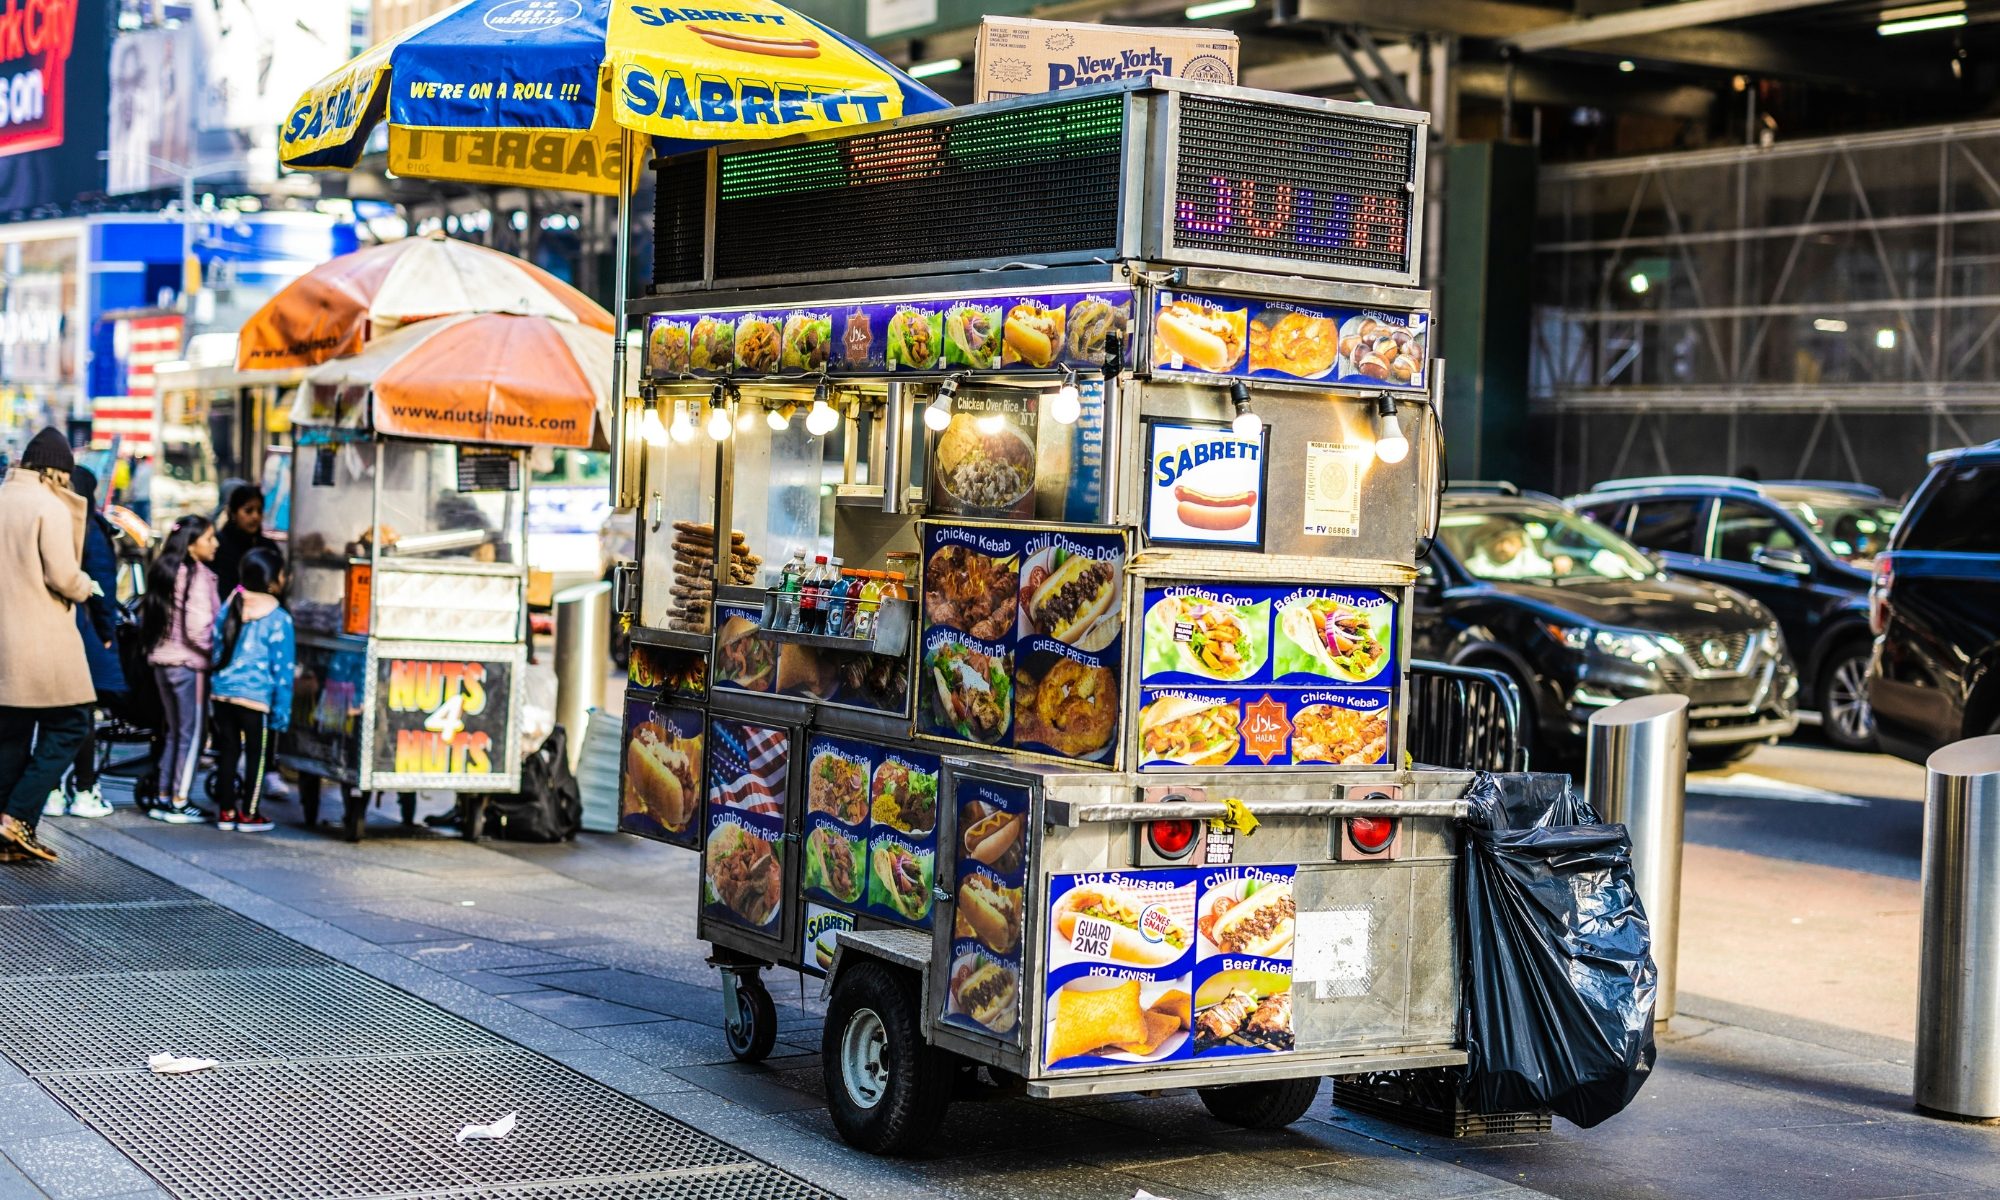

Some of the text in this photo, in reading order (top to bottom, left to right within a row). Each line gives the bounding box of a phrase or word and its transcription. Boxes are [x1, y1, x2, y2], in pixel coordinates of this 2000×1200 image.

[631, 5, 785, 26] SABRETT
[1077, 55, 1115, 76] New
[1120, 47, 1163, 68] York
[410, 81, 581, 100] WE'RE ON A ROLL !!!
[622, 64, 888, 124] SABRETT
[959, 300, 966, 308] or
[967, 300, 983, 313] Lamb
[1020, 296, 1049, 311] Chili Dog
[1086, 293, 1096, 301] Hot
[1180, 293, 1223, 312] Chili Dog
[895, 303, 935, 317] Chicken Gyro
[1265, 301, 1325, 320] CHEESE PRETZEL
[1362, 308, 1405, 327] CHESTNUTS
[957, 396, 1019, 413] Chicken Over Rice
[1022, 398, 1027, 412] I
[1020, 413, 1037, 427] NY
[1155, 438, 1260, 487] SABRETT
[936, 526, 1011, 553] Chicken Kebab
[1316, 525, 1326, 533] FV
[1025, 533, 1119, 562] Chili Cheese Dog
[1164, 586, 1253, 608] Chicken Gyro
[1274, 587, 1385, 612] Beef or Lamb Gyro
[724, 608, 745, 618] ITALIAN
[926, 628, 1006, 658] Chicken Kebab on Pit
[1033, 640, 1102, 669] CHEESE PRETZEL
[389, 660, 488, 716] NUTS
[1151, 689, 1227, 705] ITALIAN SAUSAGE
[1300, 692, 1379, 708] Chicken Kebab
[424, 694, 465, 744] 4
[648, 709, 683, 739] Chili Dog
[1250, 713, 1281, 735] حلال
[1255, 733, 1277, 743] HALAL
[395, 730, 493, 773] NUTS
[812, 742, 868, 765] Chicken over Rice
[885, 753, 926, 774] Lamb over Rice
[979, 787, 1008, 809] Hot Dog
[712, 810, 779, 843] Combo over Rice
[815, 818, 858, 843] Chicken Gyro
[869, 831, 930, 857] Beef or Lamb Gyro
[976, 865, 1007, 889] Chili Dog
[1073, 873, 1175, 891] Hot Sausage
[1203, 868, 1240, 889] Chili
[807, 912, 853, 942] SABRETT
[1143, 916, 1167, 935] SNAIL
[1146, 909, 1171, 928] JONES
[1077, 919, 1112, 942] GUARD
[955, 942, 1018, 970] Chili Cheese Dog
[1073, 936, 1108, 957] 2MS
[1089, 966, 1156, 983] HOT KNISH
[1222, 958, 1258, 972] Beef
